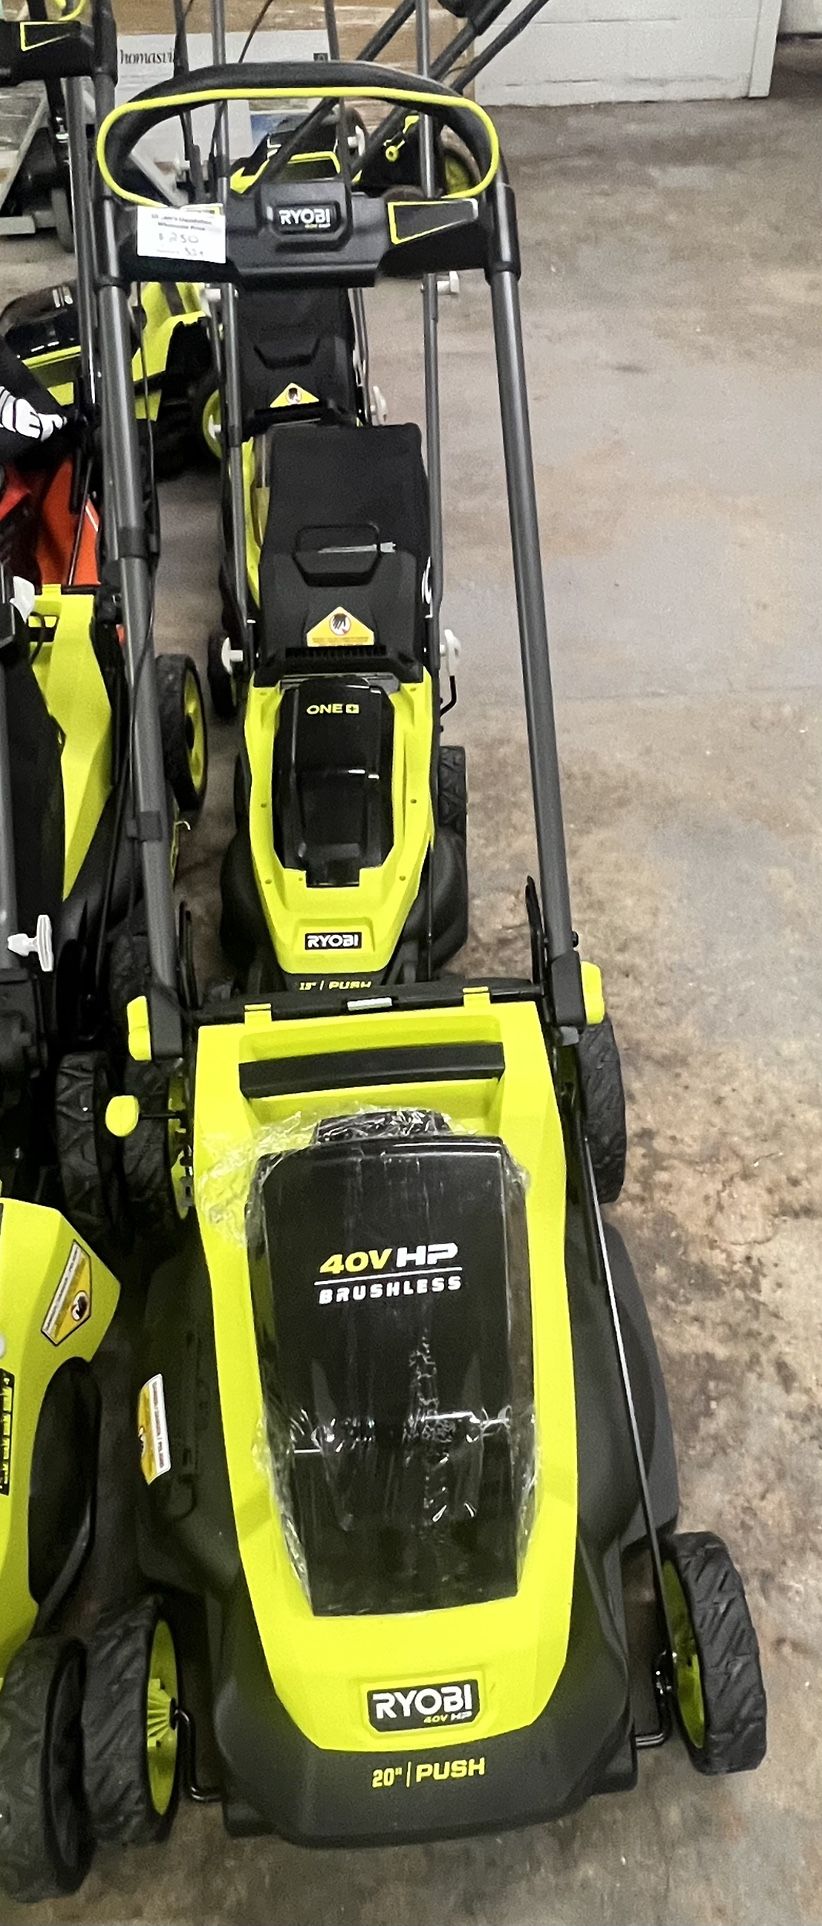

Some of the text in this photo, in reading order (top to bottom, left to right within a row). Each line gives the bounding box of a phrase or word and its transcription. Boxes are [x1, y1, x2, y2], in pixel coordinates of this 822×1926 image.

[119, 48, 175, 64] homasvi
[278, 208, 331, 224] RYOBI
[307, 934, 359, 948] RYOBI
[319, 1242, 459, 1275] 40V HP
[318, 1275, 462, 1305] BRUSHLESS
[372, 1683, 473, 1720] RYOBI
[423, 1710, 473, 1724] 40V HP
[371, 1757, 486, 1789] 20" PUSH
